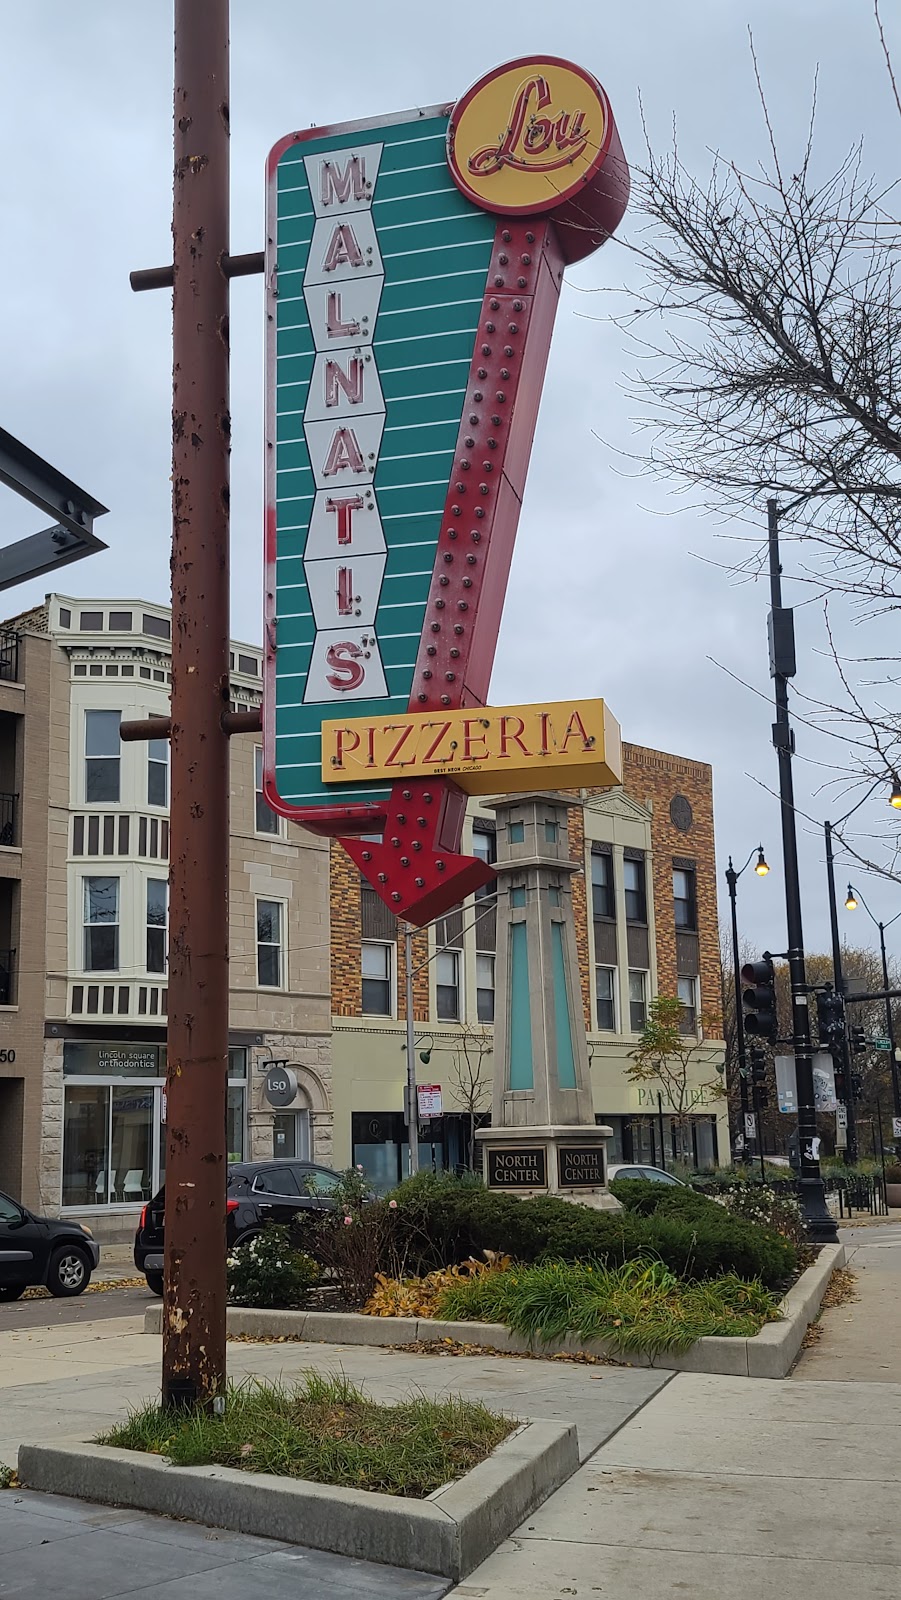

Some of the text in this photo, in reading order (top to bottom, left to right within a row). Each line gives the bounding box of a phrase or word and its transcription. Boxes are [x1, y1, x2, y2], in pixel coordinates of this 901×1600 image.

[467, 74, 590, 178] Lou
[331, 709, 597, 771] PIZZERIA
[0, 1049, 16, 1063] 50
[98, 1050, 126, 1059] lincoln
[98, 1059, 155, 1068] orthodontics
[495, 1154, 538, 1168] NORTH
[565, 1153, 599, 1166] NORTH
[494, 1168, 541, 1182] CENTER
[564, 1167, 601, 1180] CENTER
